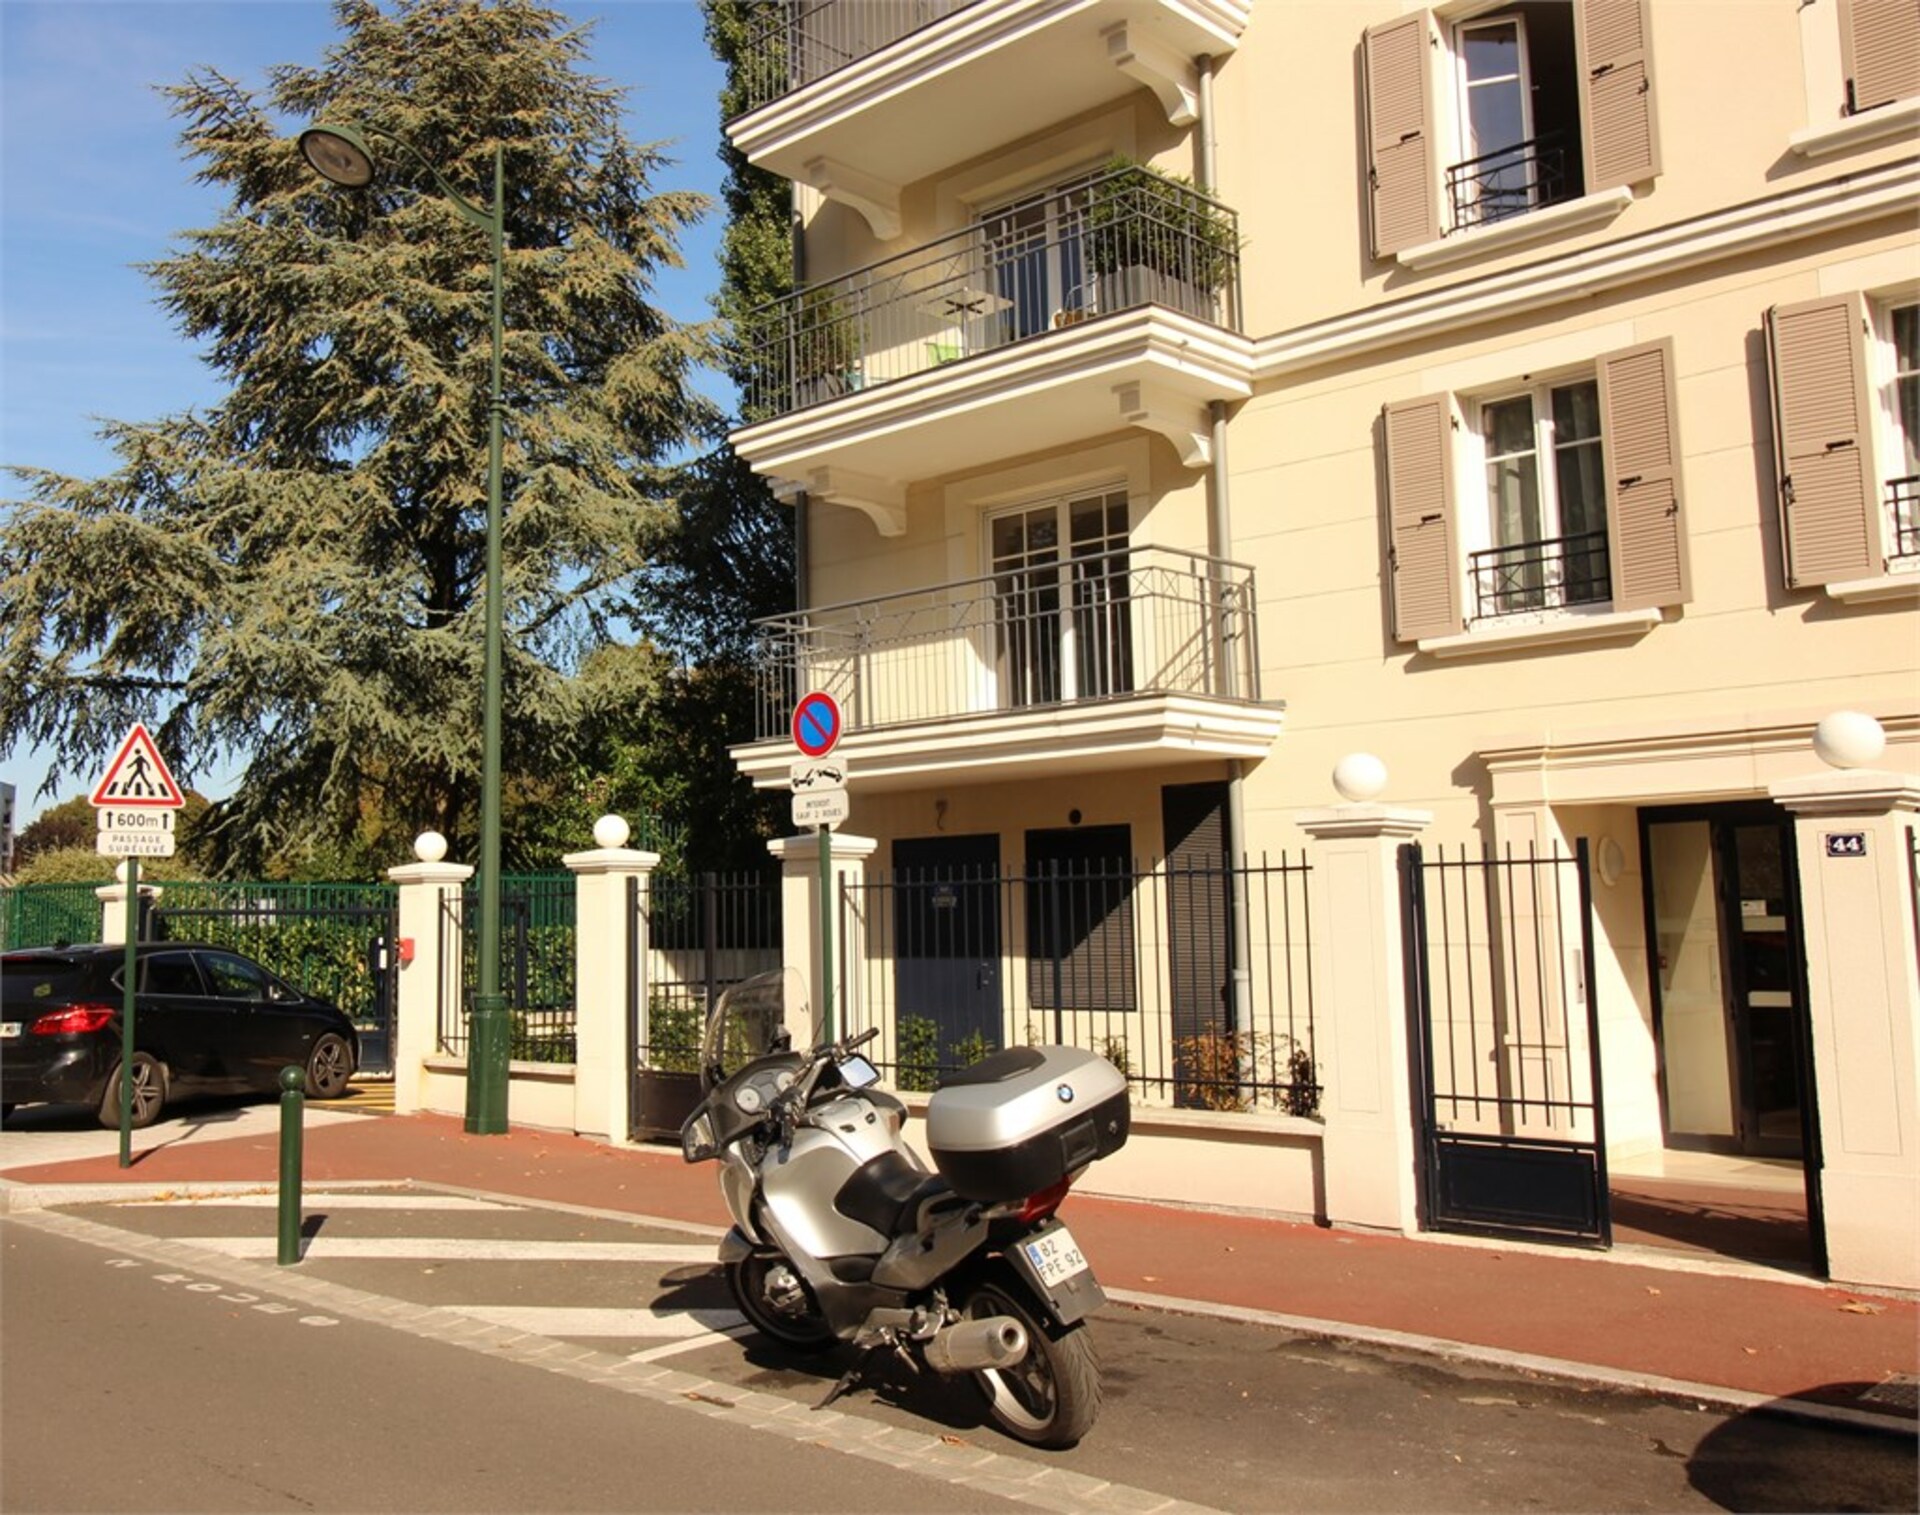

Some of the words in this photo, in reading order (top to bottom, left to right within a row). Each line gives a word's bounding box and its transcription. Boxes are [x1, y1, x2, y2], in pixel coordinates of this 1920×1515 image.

[117, 813, 159, 827] 600m
[112, 834, 161, 844] PASSAGE
[1832, 837, 1860, 852] 44
[1064, 1248, 1083, 1267] 92
